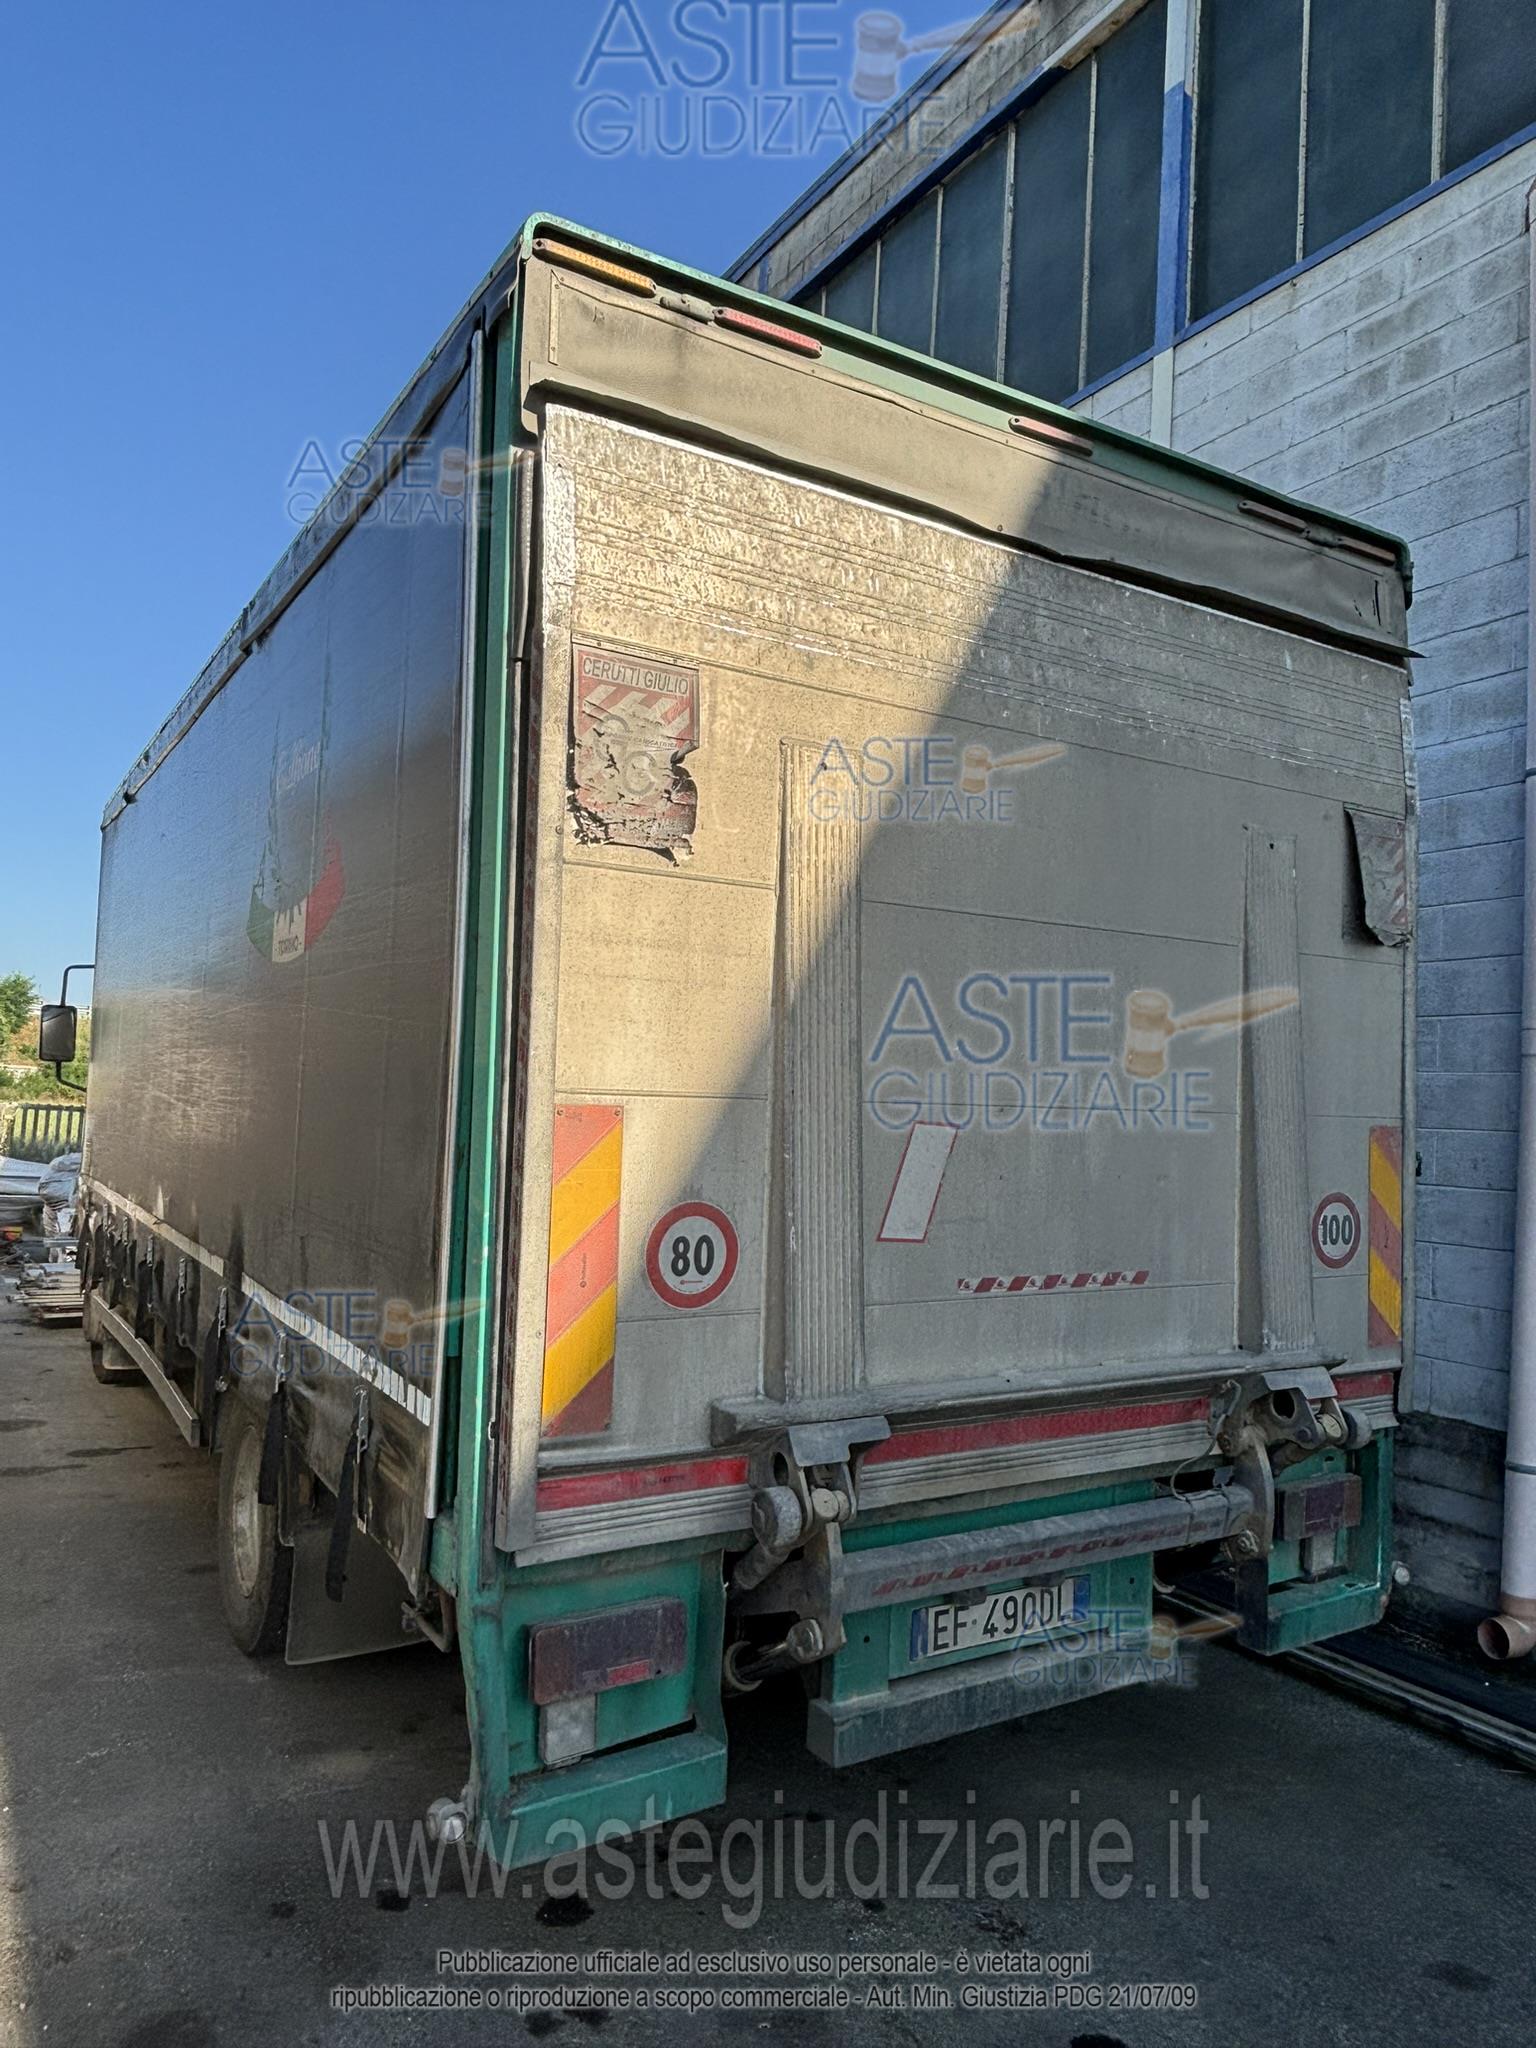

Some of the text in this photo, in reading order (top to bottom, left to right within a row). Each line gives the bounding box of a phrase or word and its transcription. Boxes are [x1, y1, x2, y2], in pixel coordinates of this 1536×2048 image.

[583, 657, 688, 695] CERUTTI GIULIO
[1321, 1214, 1354, 1246] 100
[670, 1234, 715, 1277] 80
[933, 1605, 971, 1651] EF
